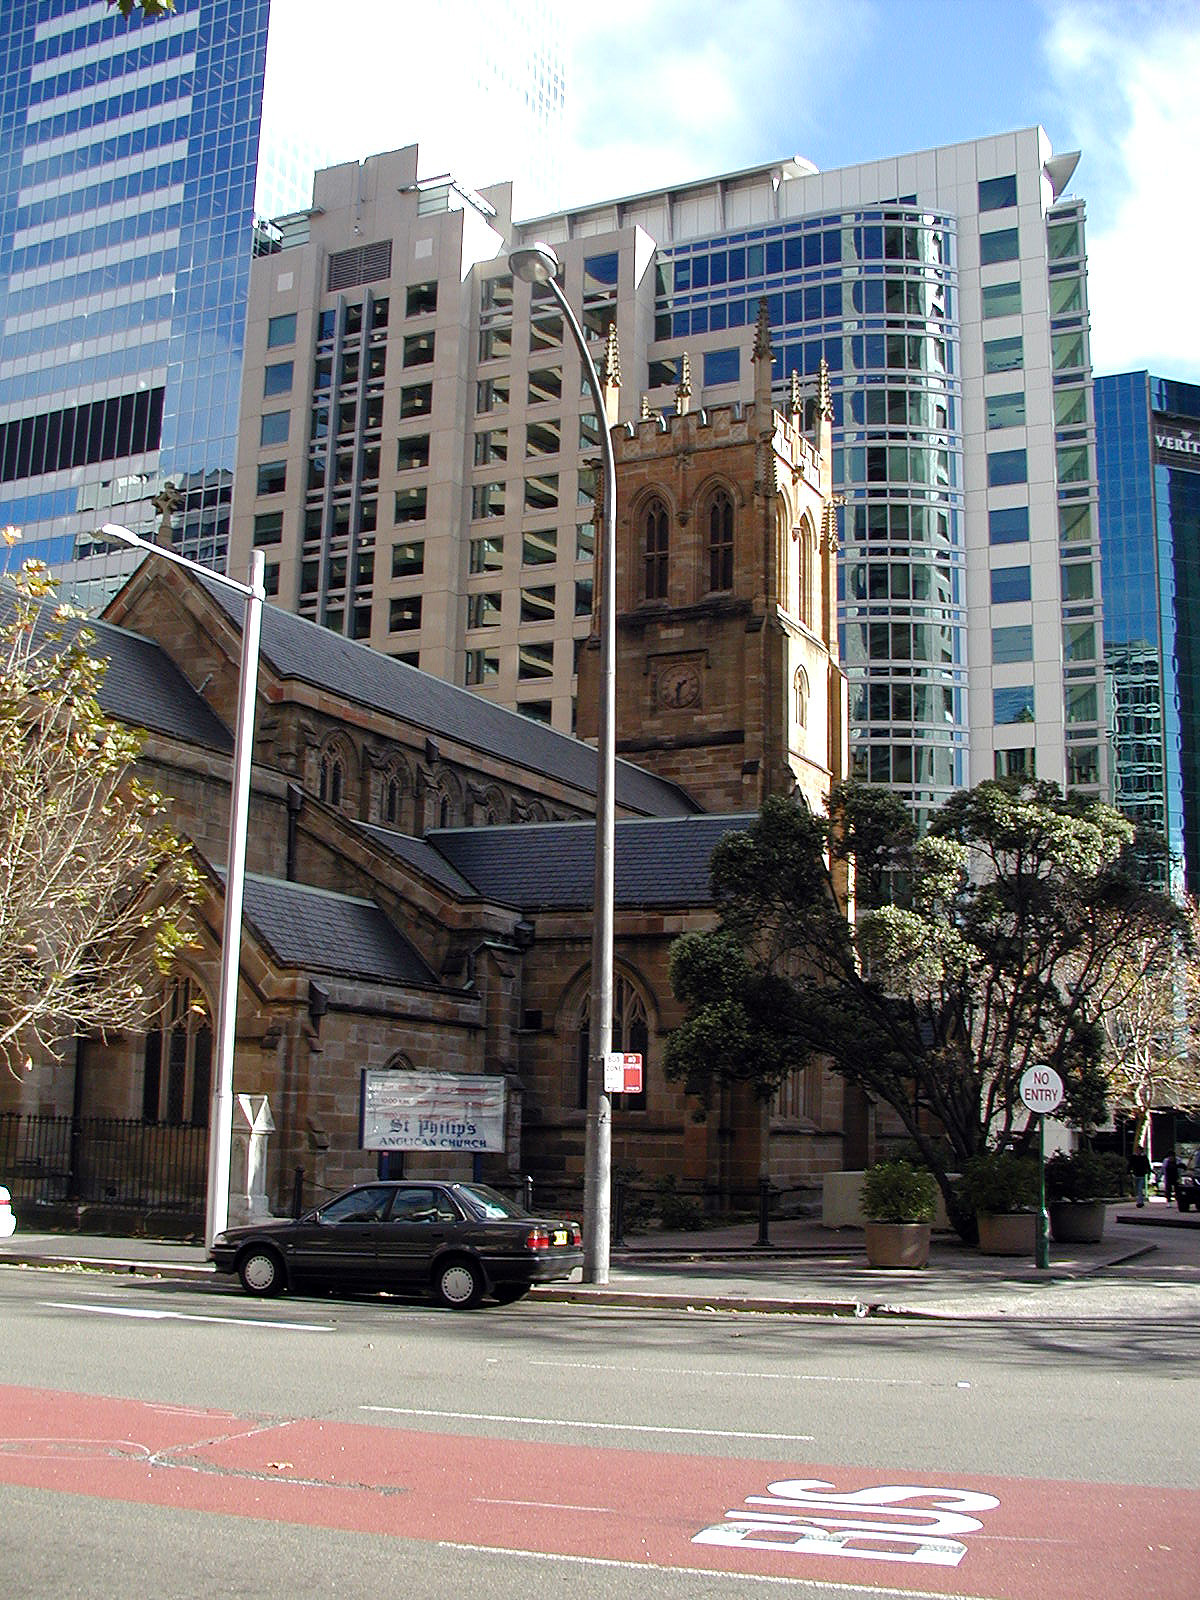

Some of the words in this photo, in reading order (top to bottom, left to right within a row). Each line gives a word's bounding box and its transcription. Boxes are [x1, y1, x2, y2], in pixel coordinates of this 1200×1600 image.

[1033, 1072, 1049, 1085] NO
[1025, 1088, 1057, 1101] ENTRY
[390, 1119, 409, 1133] St
[418, 1119, 477, 1137] Philip's
[380, 1137, 436, 1147] ANGLICAN
[440, 1139, 487, 1148] CHURCH
[690, 1478, 1001, 1567] BUS
